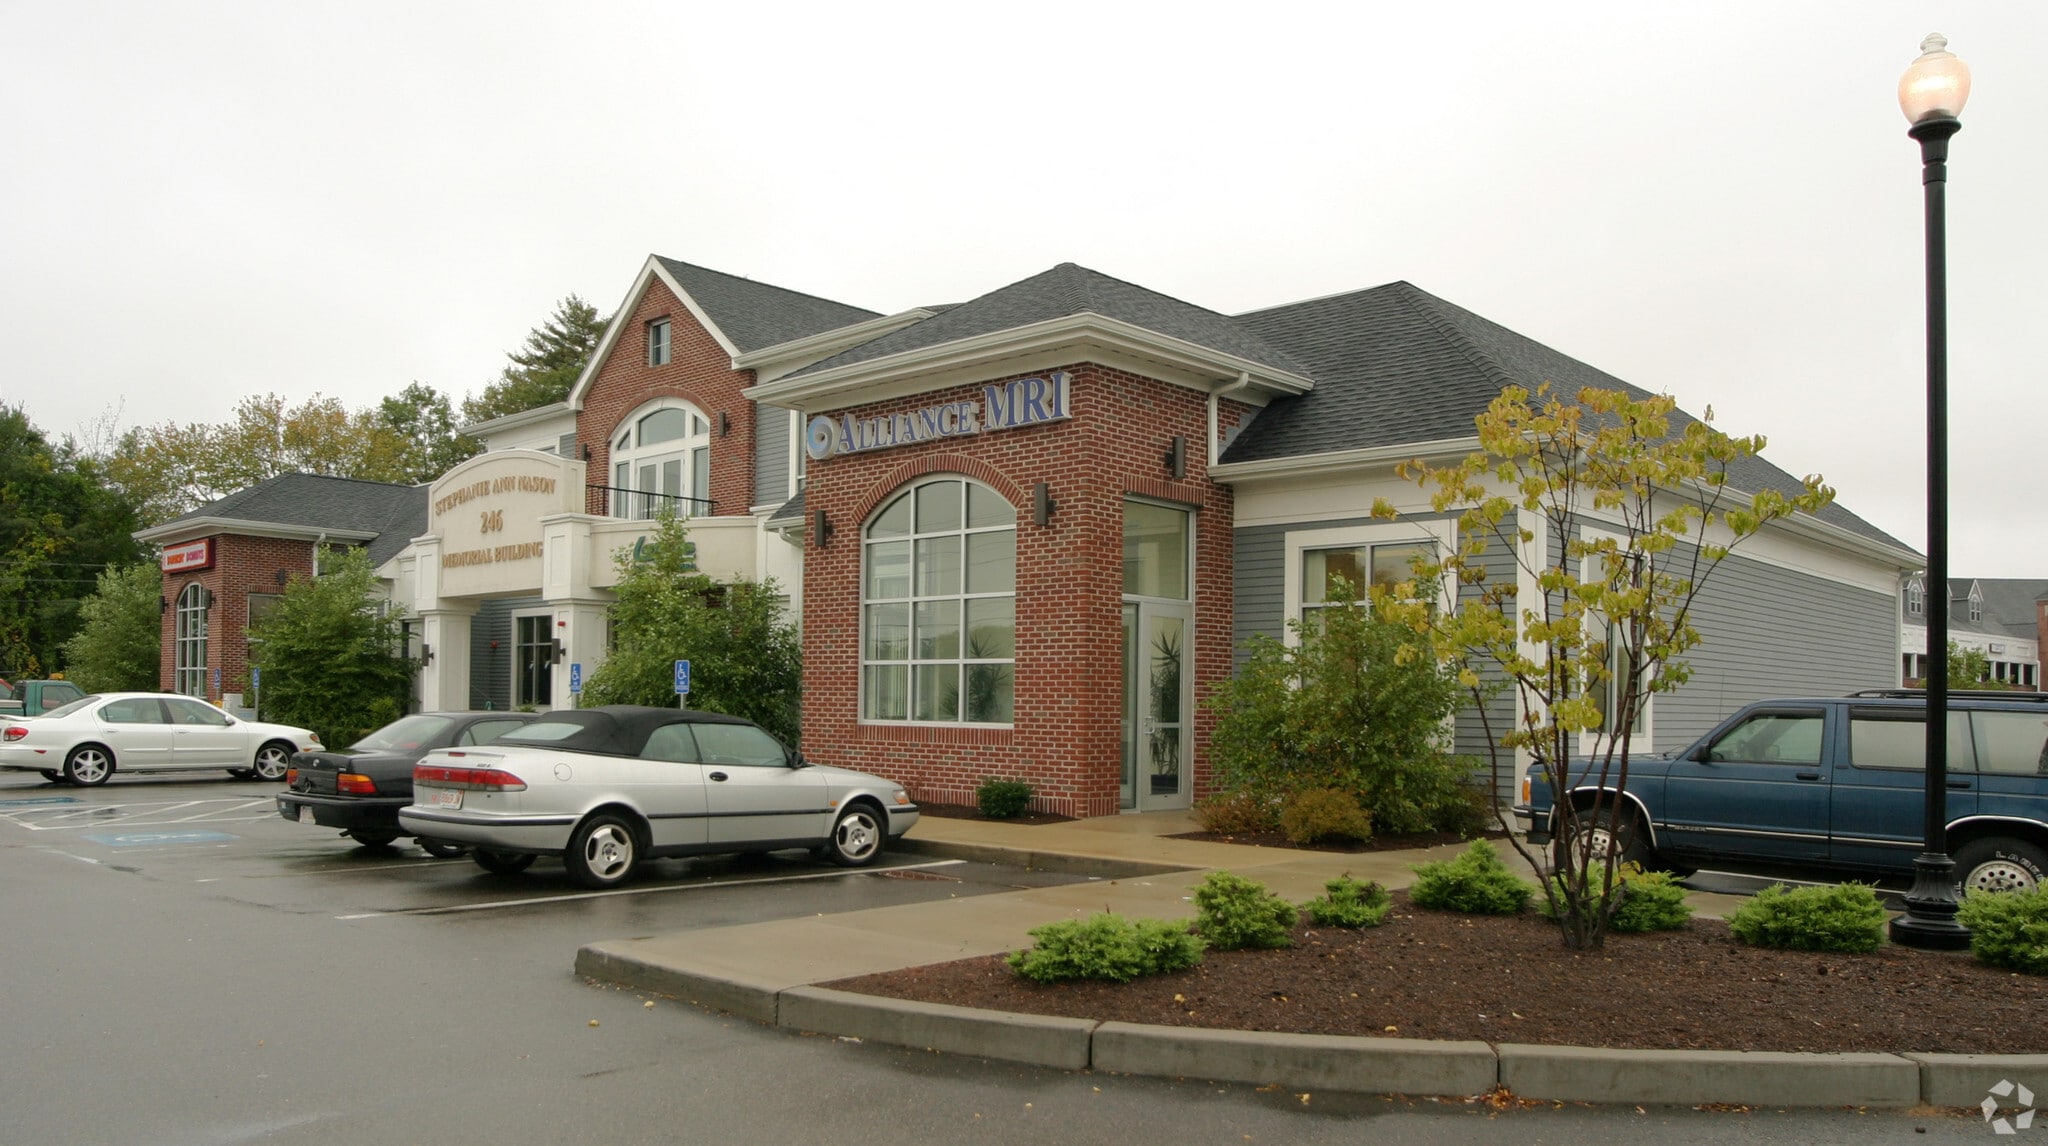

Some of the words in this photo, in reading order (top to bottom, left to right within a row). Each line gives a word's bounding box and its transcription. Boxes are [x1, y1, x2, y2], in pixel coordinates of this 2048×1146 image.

[836, 402, 981, 453] ALLIANCE
[982, 371, 1073, 431] MRI
[435, 480, 490, 516] STEPHANIE
[492, 476, 516, 494] ANN
[518, 476, 556, 494] NASON
[480, 509, 503, 533] 246
[442, 549, 493, 568] MEMORIAL
[494, 541, 543, 562] BUILDING
